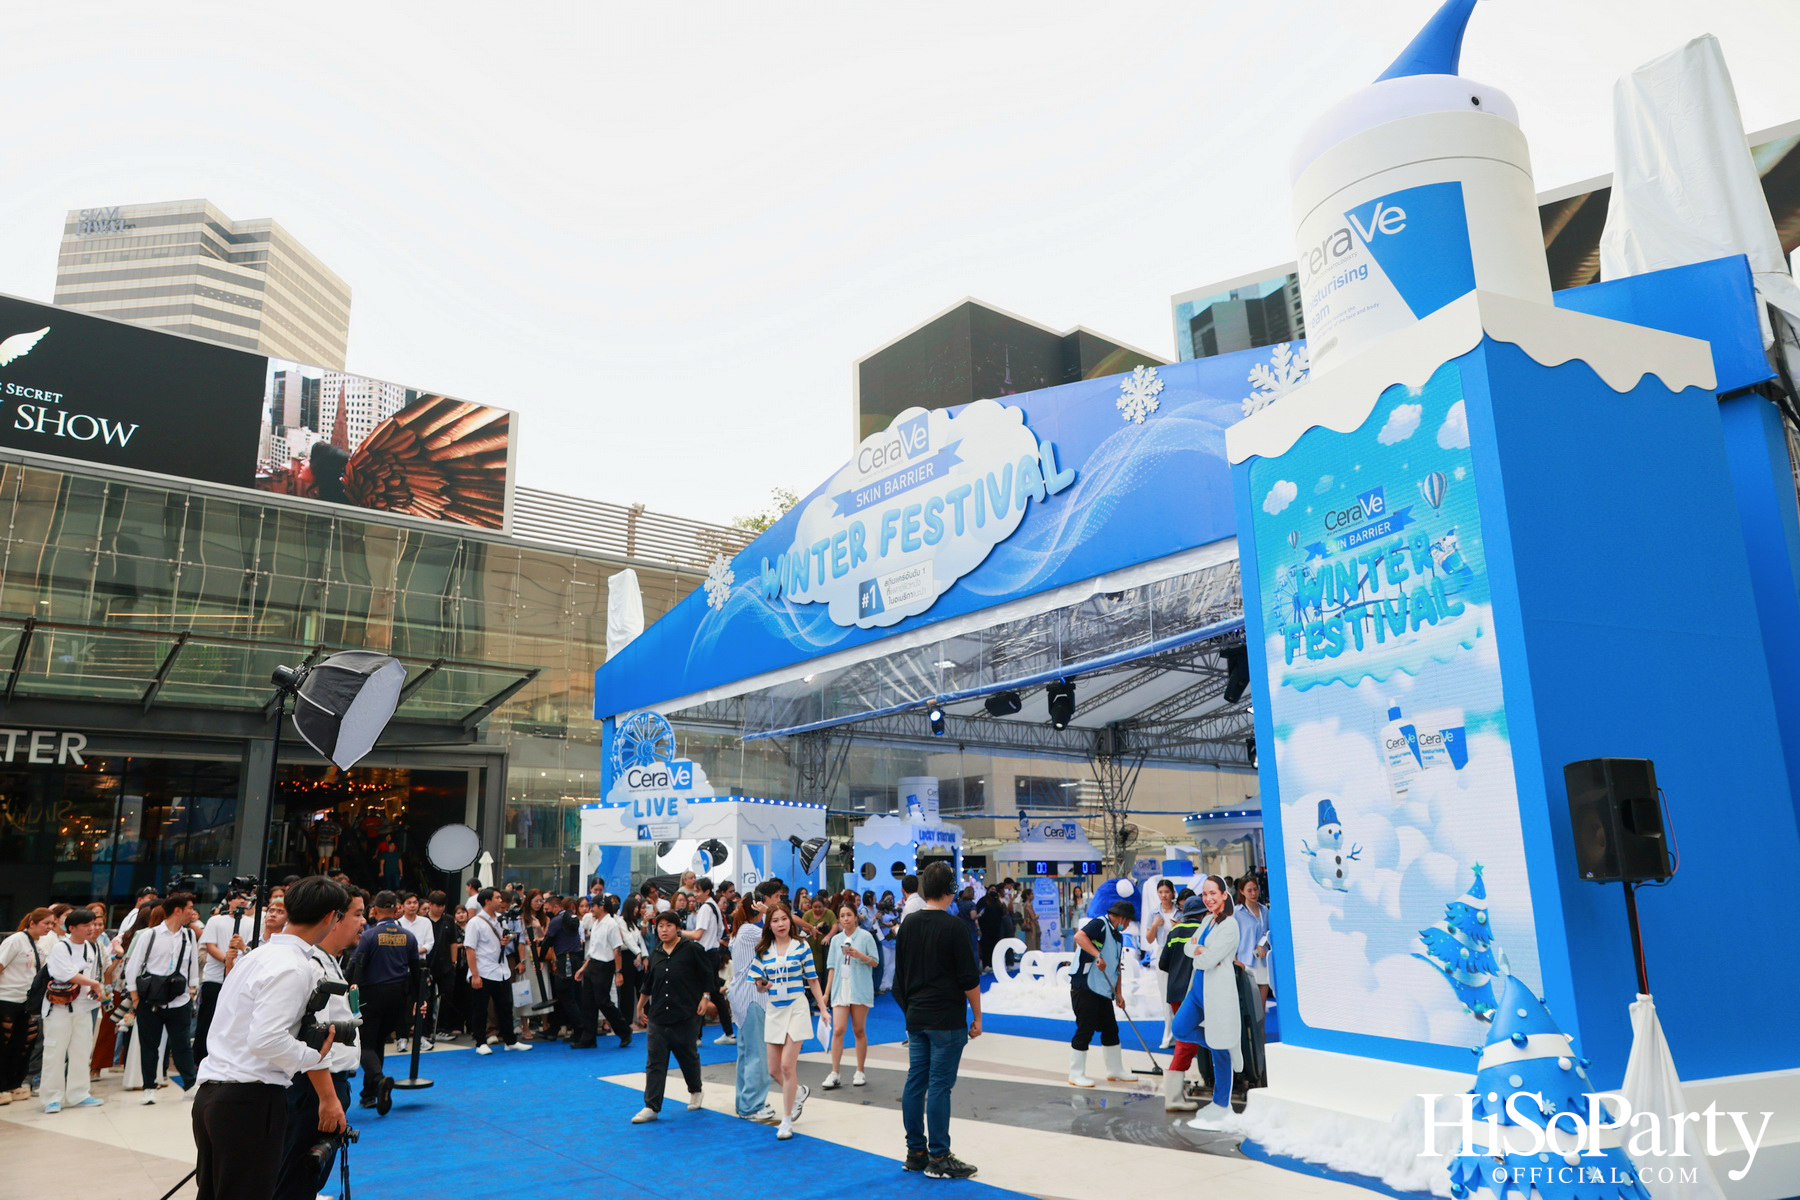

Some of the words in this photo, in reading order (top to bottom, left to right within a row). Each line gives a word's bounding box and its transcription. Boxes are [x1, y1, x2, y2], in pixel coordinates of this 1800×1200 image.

[1306, 263, 1369, 314] oisturising
[6, 382, 63, 404] SECRET
[14, 404, 140, 448] SHOW
[858, 423, 927, 474] CeraVe
[856, 485, 881, 508] SKIN
[884, 462, 934, 496] BARRIER
[760, 519, 868, 600] WINTER
[880, 440, 1076, 558] FESTIVAL
[1325, 494, 1383, 530] CeraVe
[1349, 521, 1392, 546] BARRIER
[1296, 531, 1434, 609] WINTER
[861, 584, 876, 609] #1
[1284, 576, 1466, 666] FESTIVAL
[0, 728, 88, 766] TER
[1386, 733, 1416, 750] CeraVe
[1418, 731, 1454, 746] CeraVe
[628, 766, 691, 789] CeraVe
[633, 796, 679, 818] LIVE
[1043, 824, 1075, 838] CeraVe
